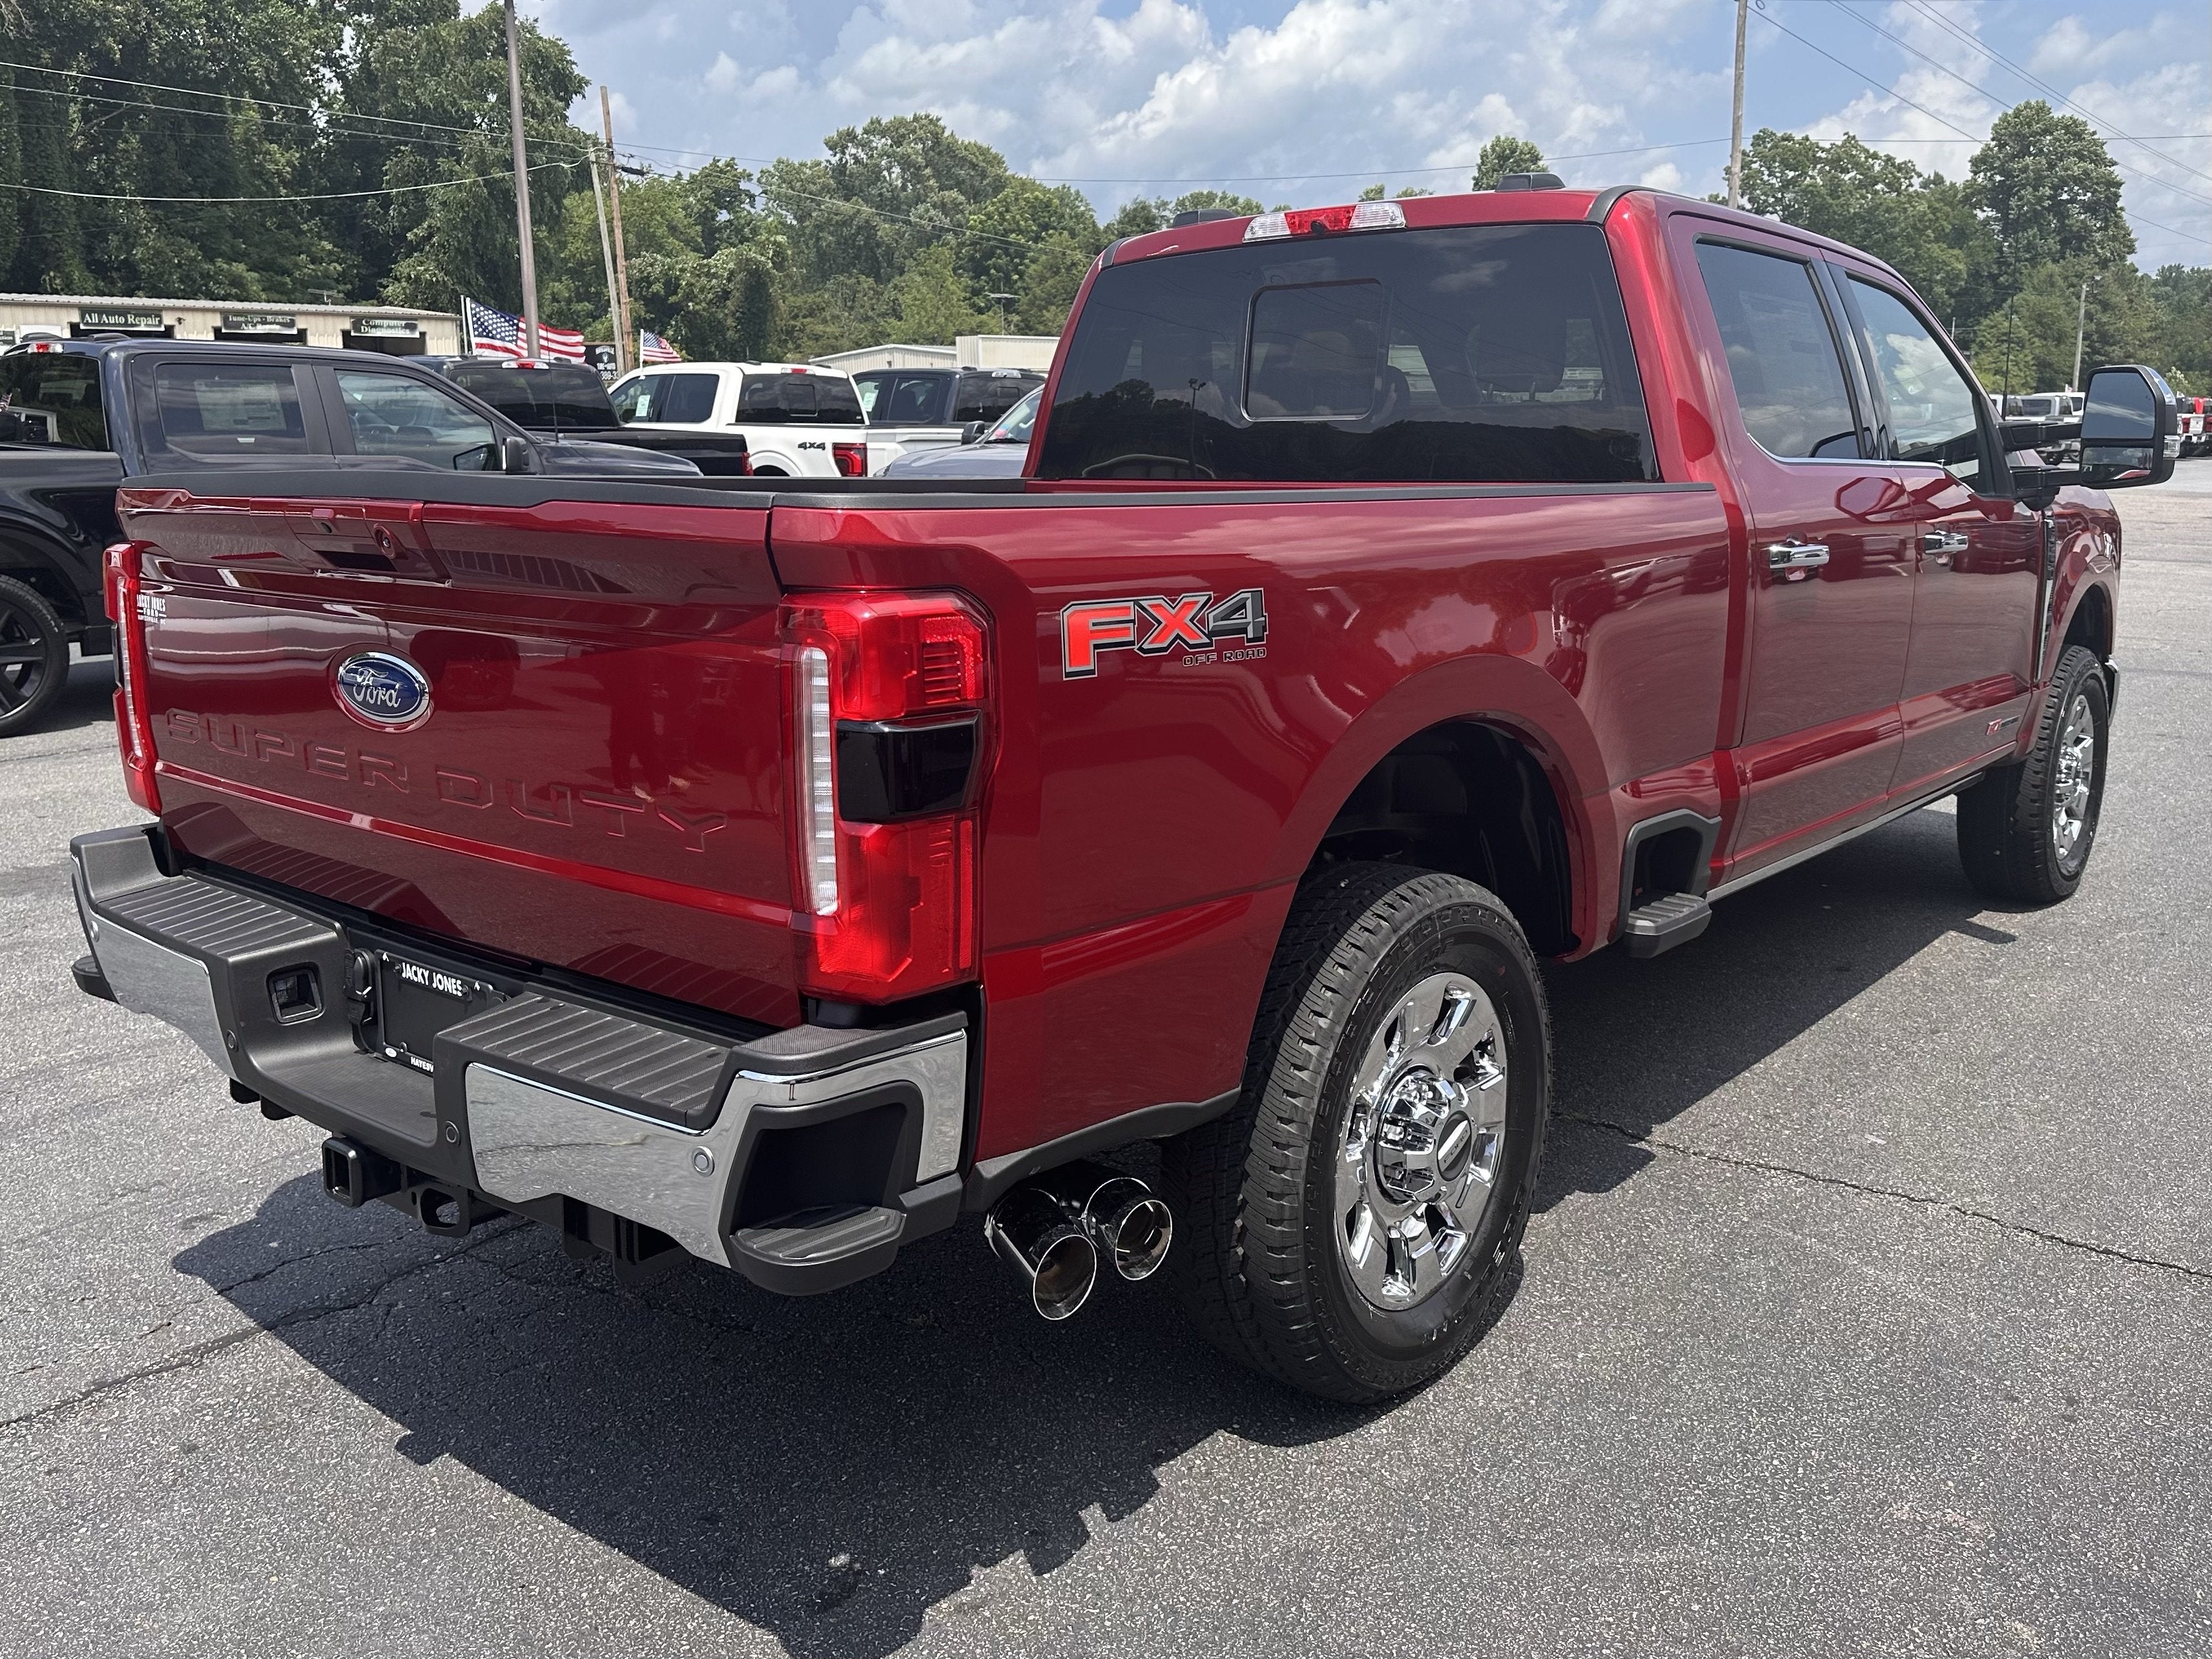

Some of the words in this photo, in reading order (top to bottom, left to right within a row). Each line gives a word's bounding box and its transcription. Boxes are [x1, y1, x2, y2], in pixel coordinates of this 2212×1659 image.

[83, 313, 99, 324] All
[101, 314, 125, 324] Auto
[127, 314, 161, 327] Repair
[143, 608, 159, 617] FORD
[151, 596, 166, 612] JONES
[1060, 588, 1268, 681] FX4
[1183, 652, 1217, 667] OFF
[1223, 647, 1267, 663] ROAD
[344, 665, 408, 708] Ford
[165, 708, 409, 794] SUPER
[435, 763, 728, 853] DUTY
[402, 962, 429, 985] JACKY
[432, 972, 462, 996] JONES
[410, 1056, 434, 1073] HAYESV
